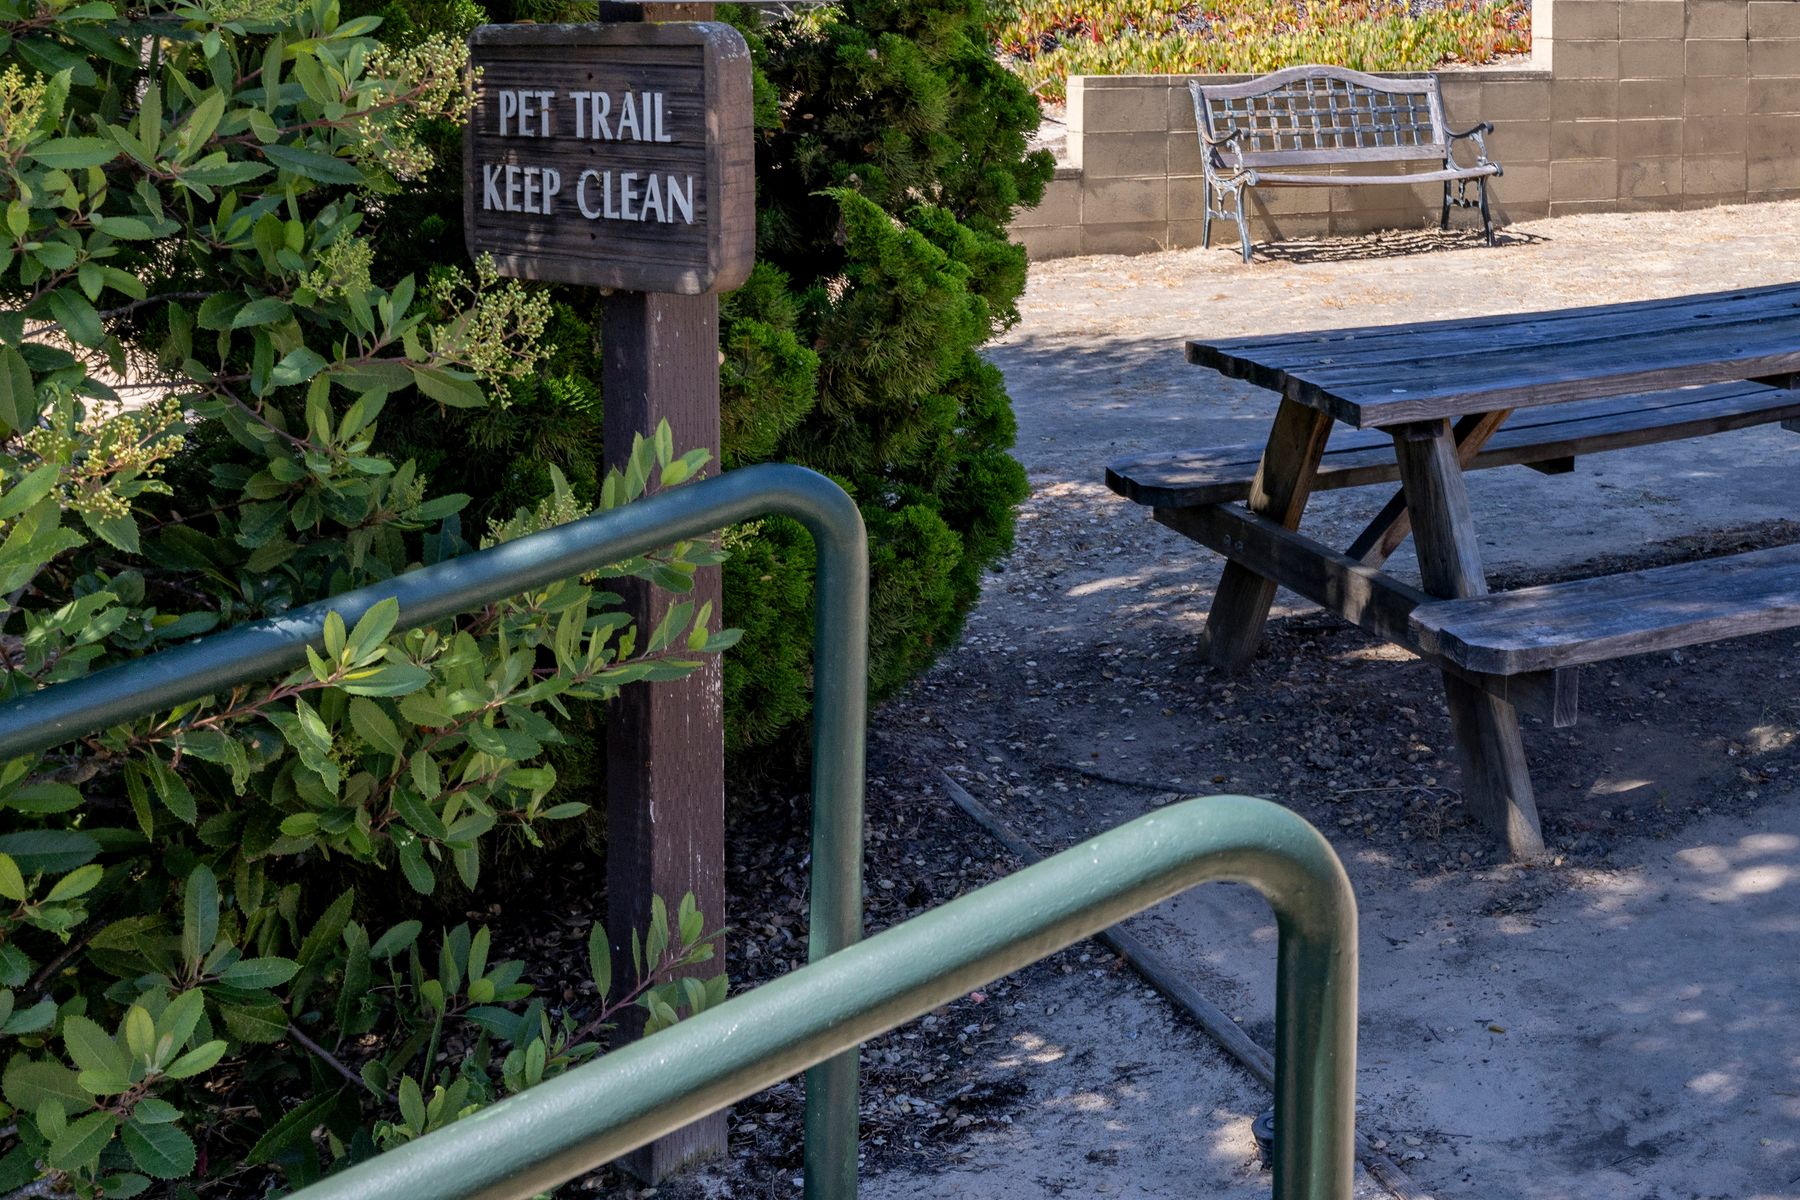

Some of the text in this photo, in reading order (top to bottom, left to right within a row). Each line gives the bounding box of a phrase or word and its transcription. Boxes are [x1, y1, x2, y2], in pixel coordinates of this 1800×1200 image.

[499, 90, 671, 142] PET TRAIL
[483, 164, 694, 224] KEEP CLEAN
